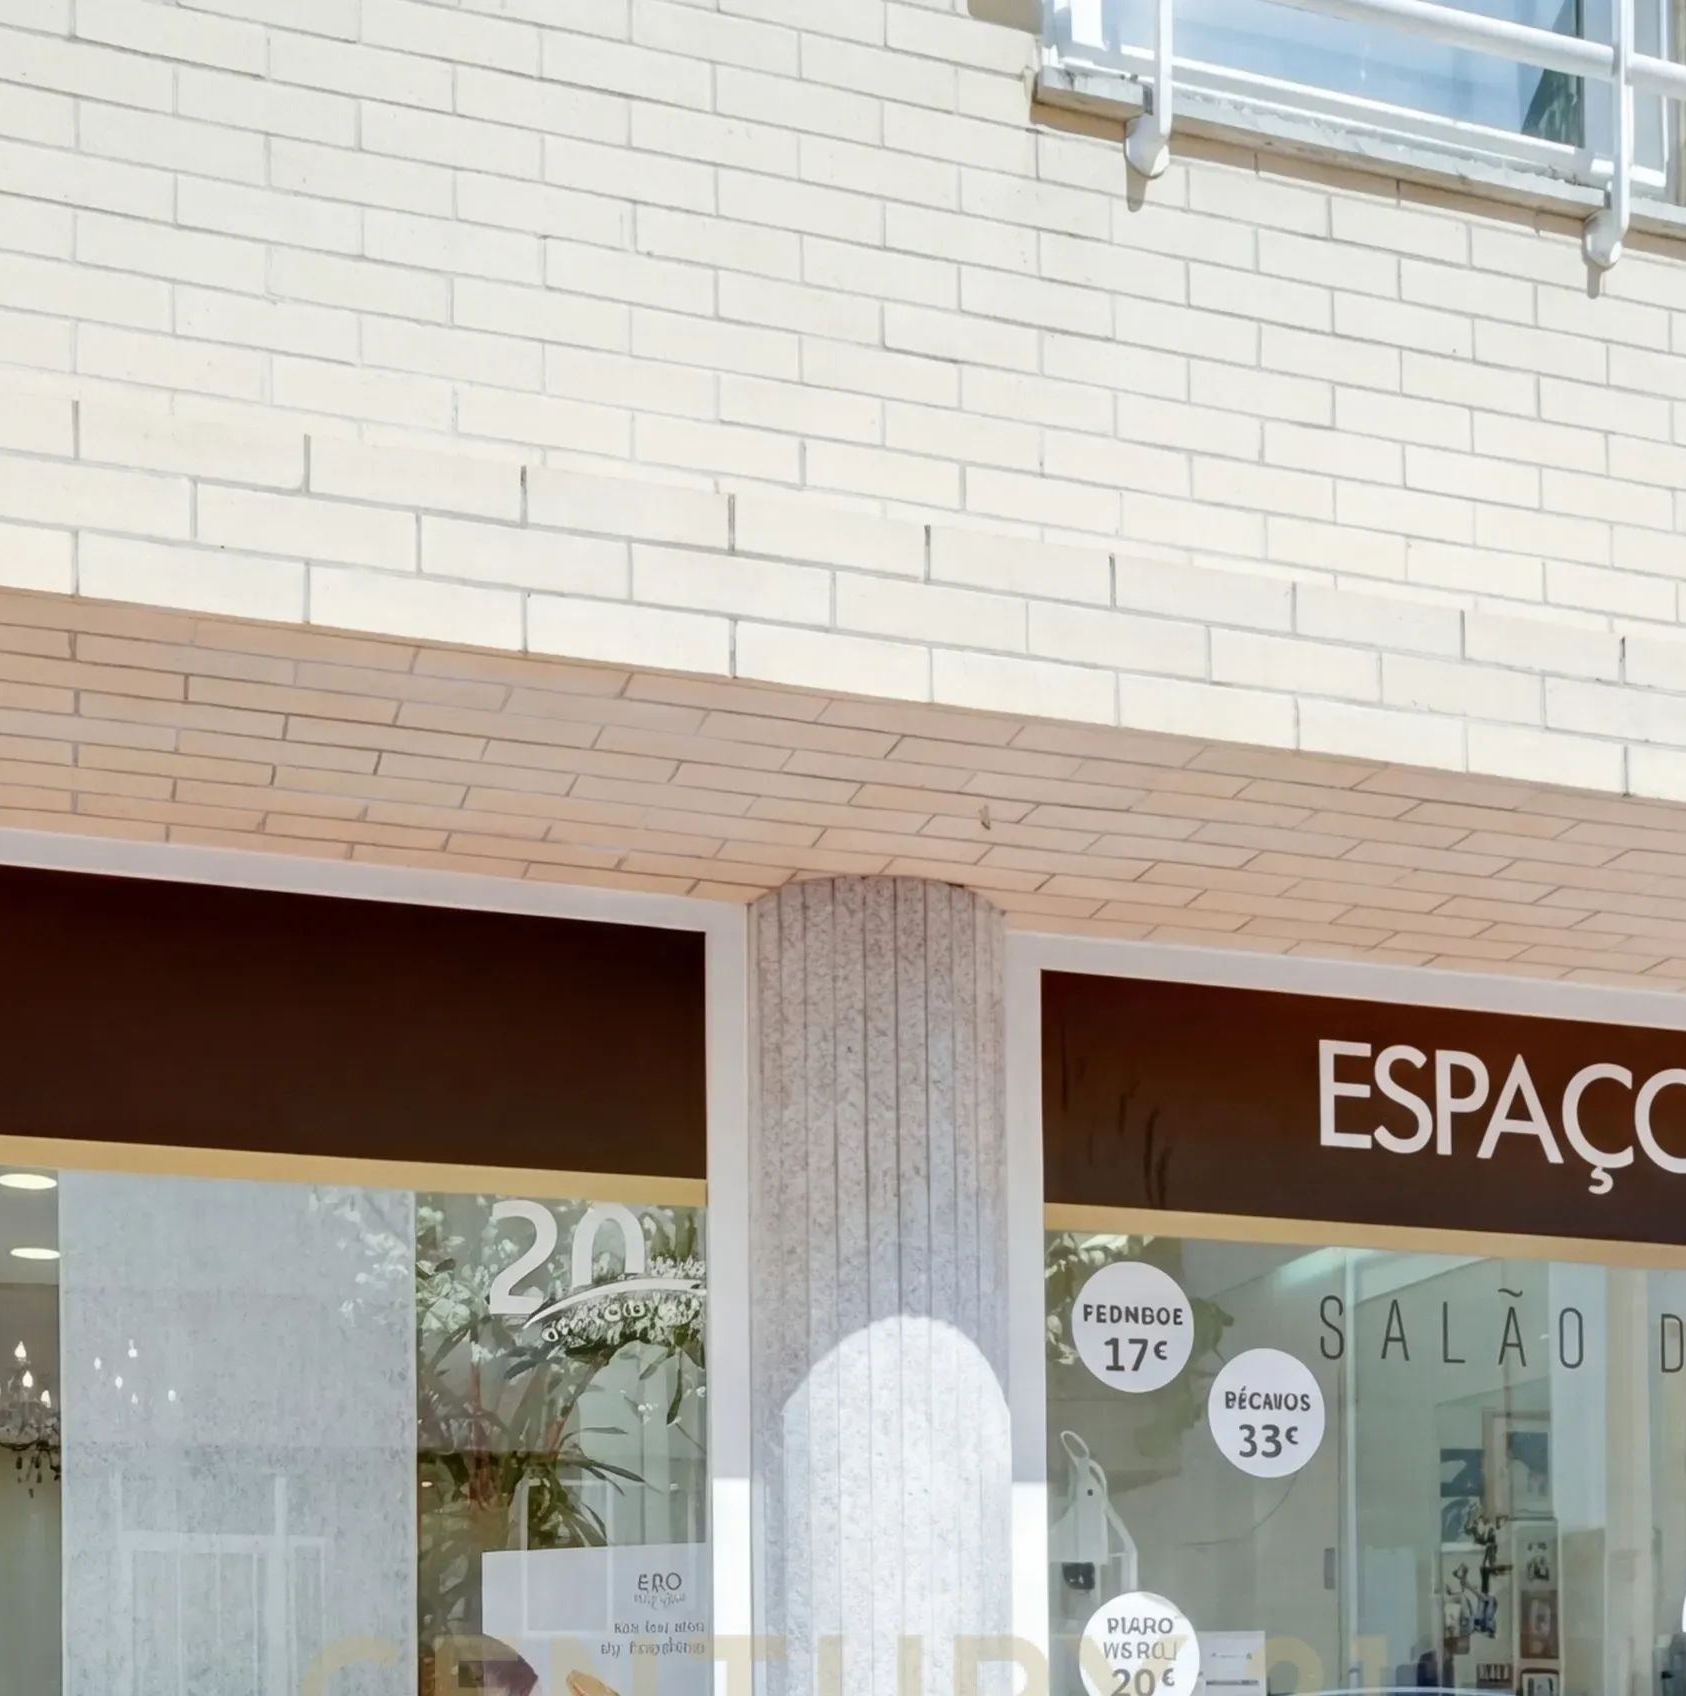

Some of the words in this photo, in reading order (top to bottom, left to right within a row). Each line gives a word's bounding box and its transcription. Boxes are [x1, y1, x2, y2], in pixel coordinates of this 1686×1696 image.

[1319, 1287, 1585, 1370] SALÃO
[1103, 1337, 1168, 1372] 17€
[1238, 1423, 1299, 1458] 33€
